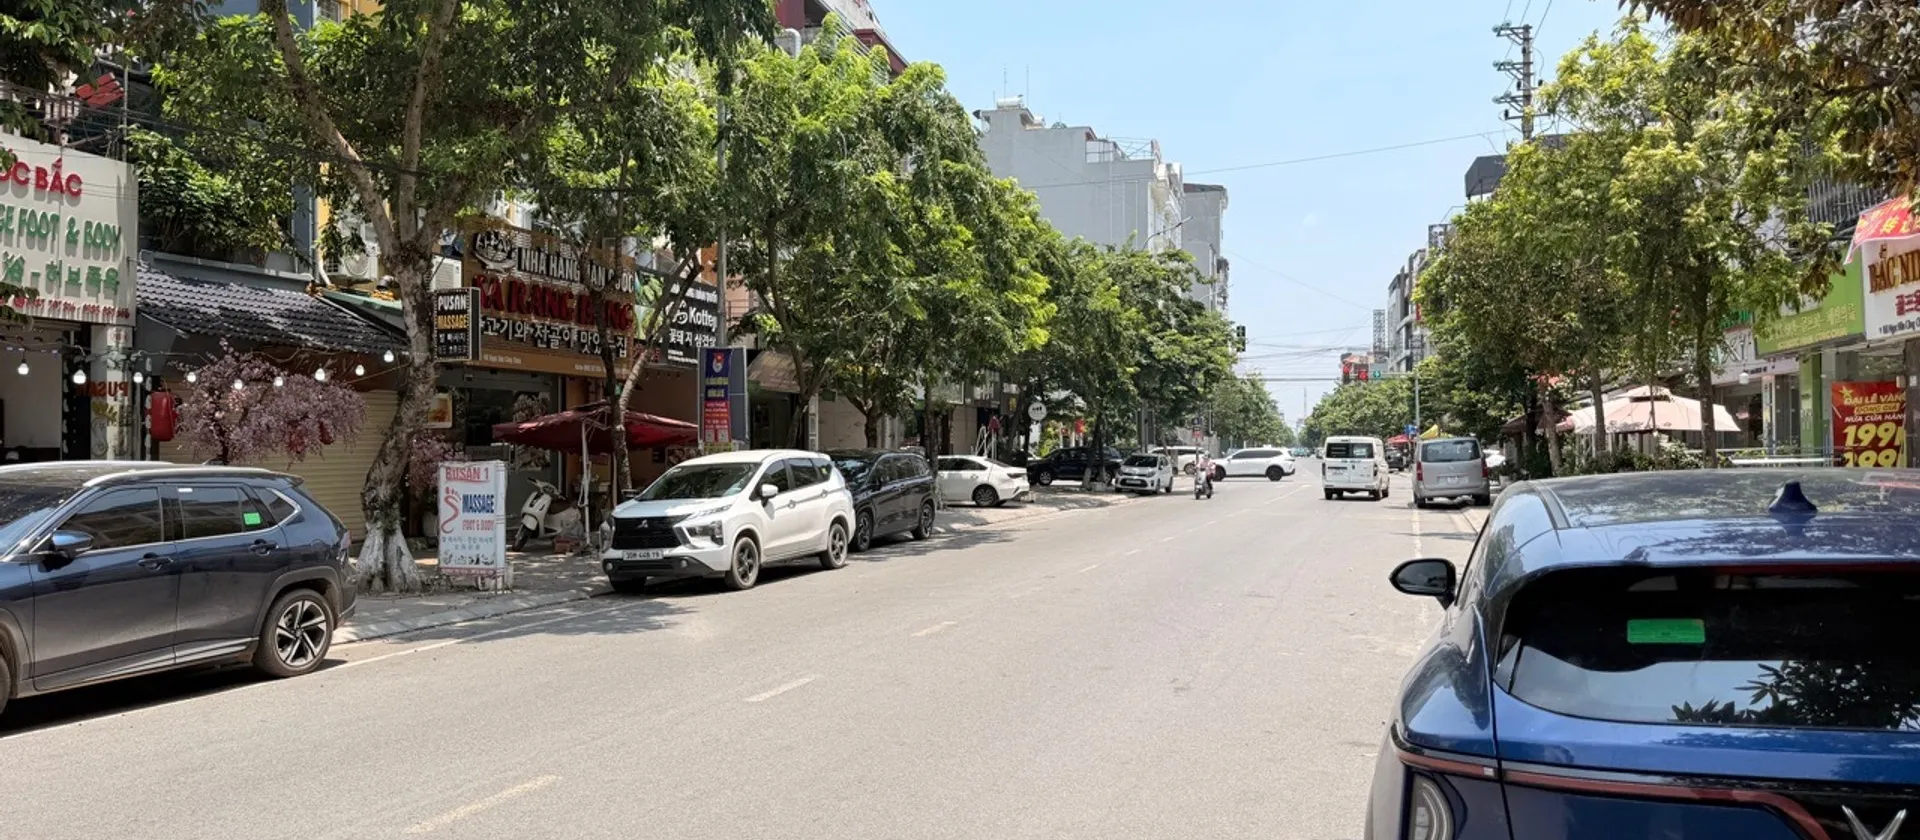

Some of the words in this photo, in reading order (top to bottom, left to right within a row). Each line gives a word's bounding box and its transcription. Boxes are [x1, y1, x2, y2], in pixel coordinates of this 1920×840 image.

[36, 158, 82, 197] BẮC
[19, 208, 60, 240] FOOT
[67, 216, 80, 244] &
[84, 220, 121, 249] BODY
[438, 295, 467, 311] PUSAN
[437, 315, 467, 329] MASSAGE
[462, 494, 494, 514] MASSAGE
